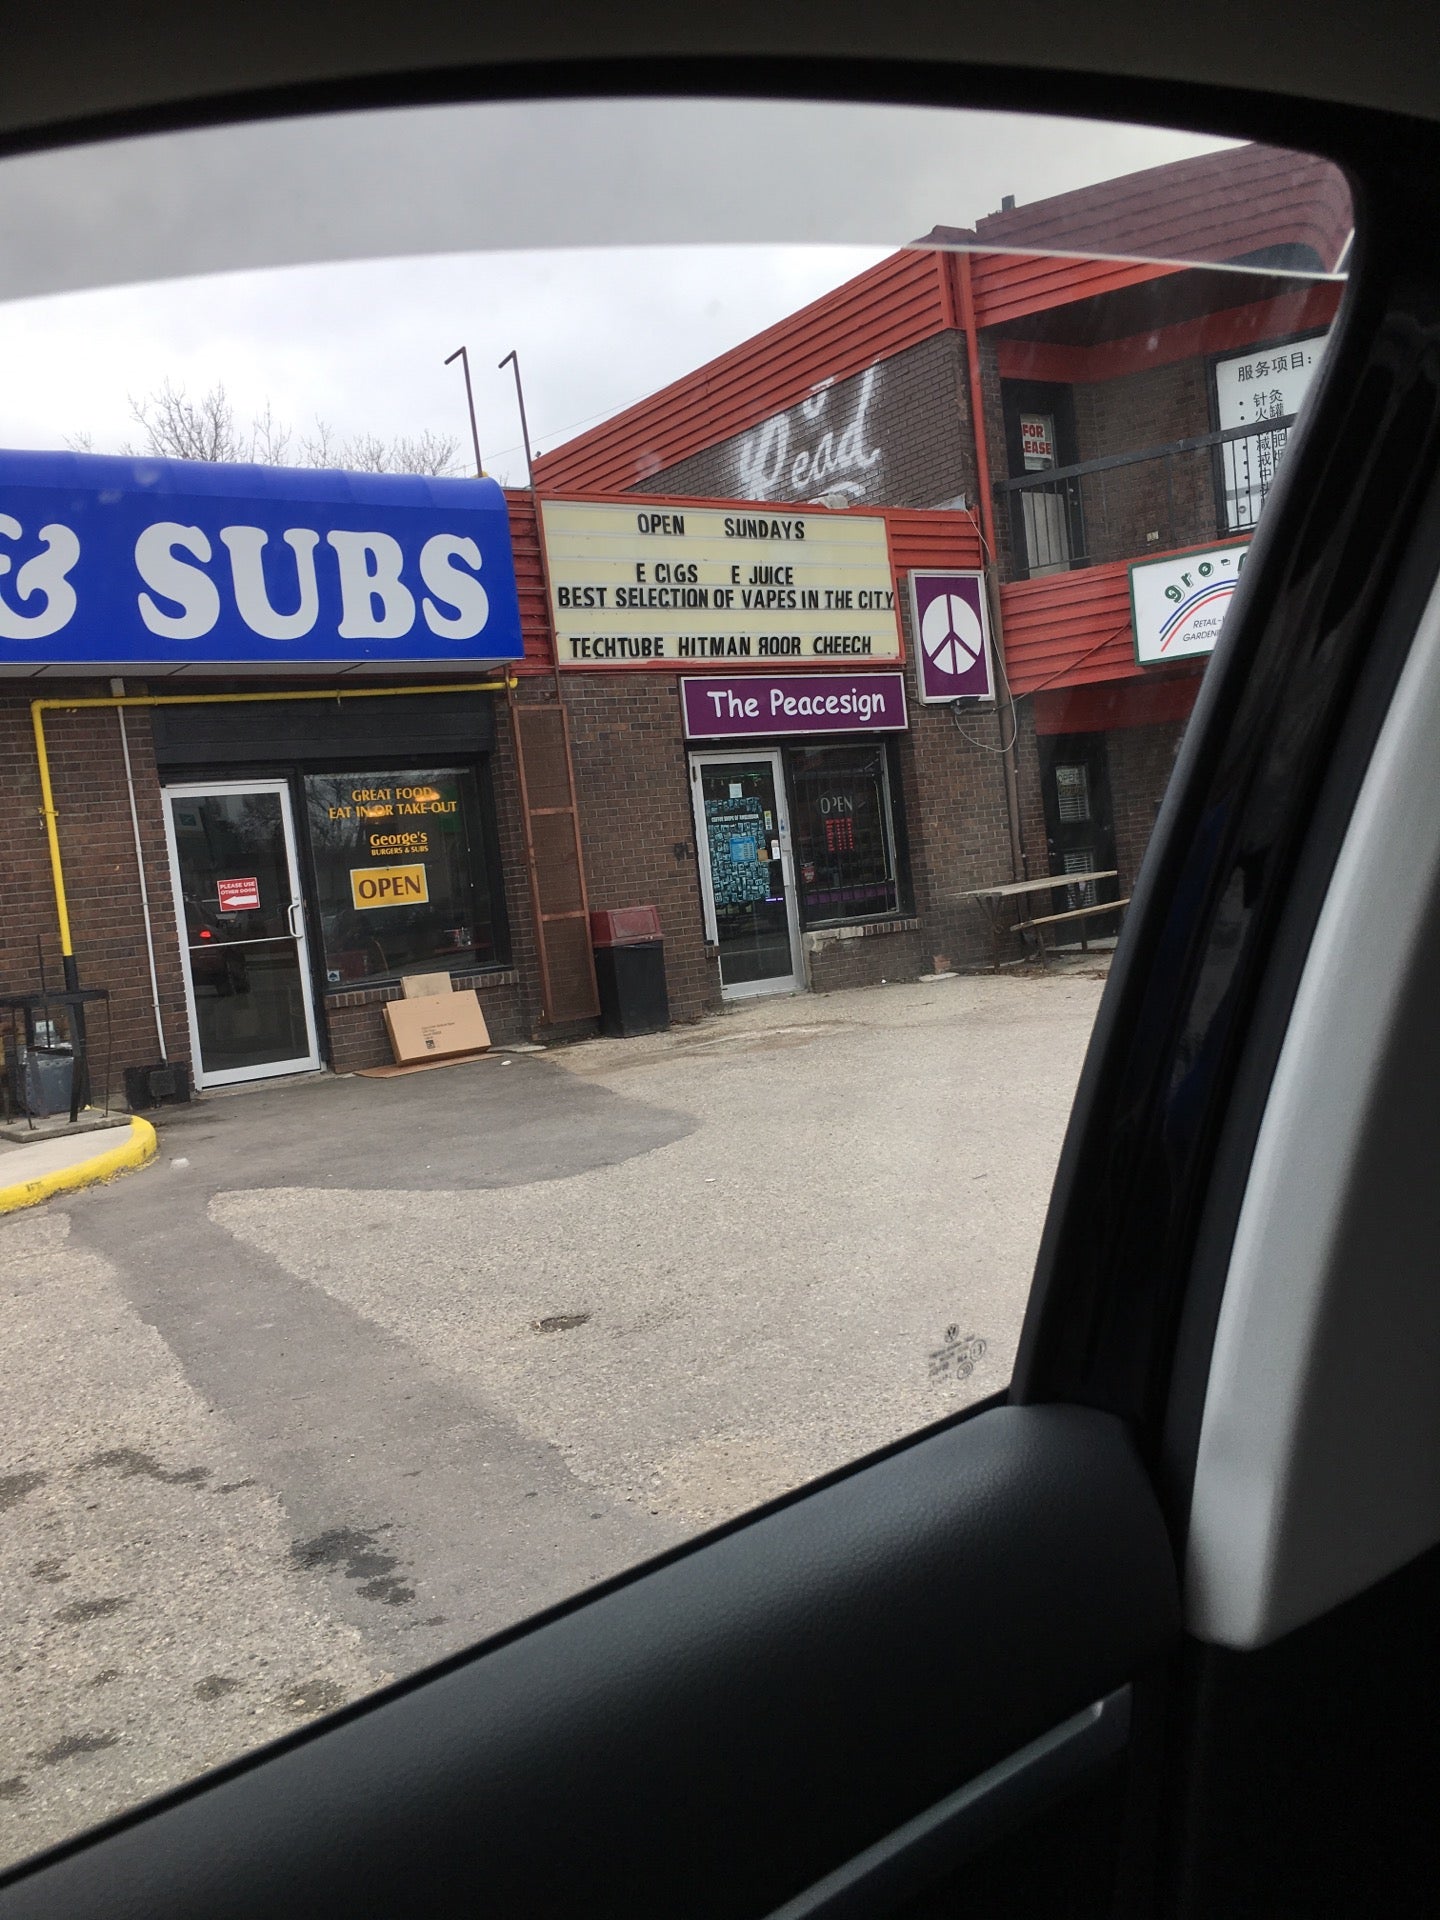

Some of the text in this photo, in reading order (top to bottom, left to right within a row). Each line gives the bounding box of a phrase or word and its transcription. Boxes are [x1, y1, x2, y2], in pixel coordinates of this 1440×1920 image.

[1238, 351, 1312, 382] 服务项目:
[1253, 389, 1283, 407] 针灸
[1022, 424, 1044, 438] FOR
[1023, 441, 1052, 455] EASE
[637, 513, 805, 539] OPEN SUNDAYS
[134, 521, 490, 641] SUBS
[636, 563, 794, 585] E CIGS E JUICE
[558, 587, 895, 609] BEST SELECTION OF VAPES IN THE CITY
[1192, 615, 1226, 629] RETAIL-
[570, 637, 665, 658] TECHTUBE
[678, 636, 751, 656] HITMAN
[813, 635, 872, 655] CHEECH
[707, 688, 886, 721] The Peacesign
[352, 786, 432, 801] GREAT FOOD
[329, 801, 457, 819] EAT IN OR TAKE-OUT
[370, 832, 428, 846] George's
[371, 847, 402, 856] BURGERS
[411, 845, 429, 853] SUBS
[358, 874, 421, 899] OPEN
